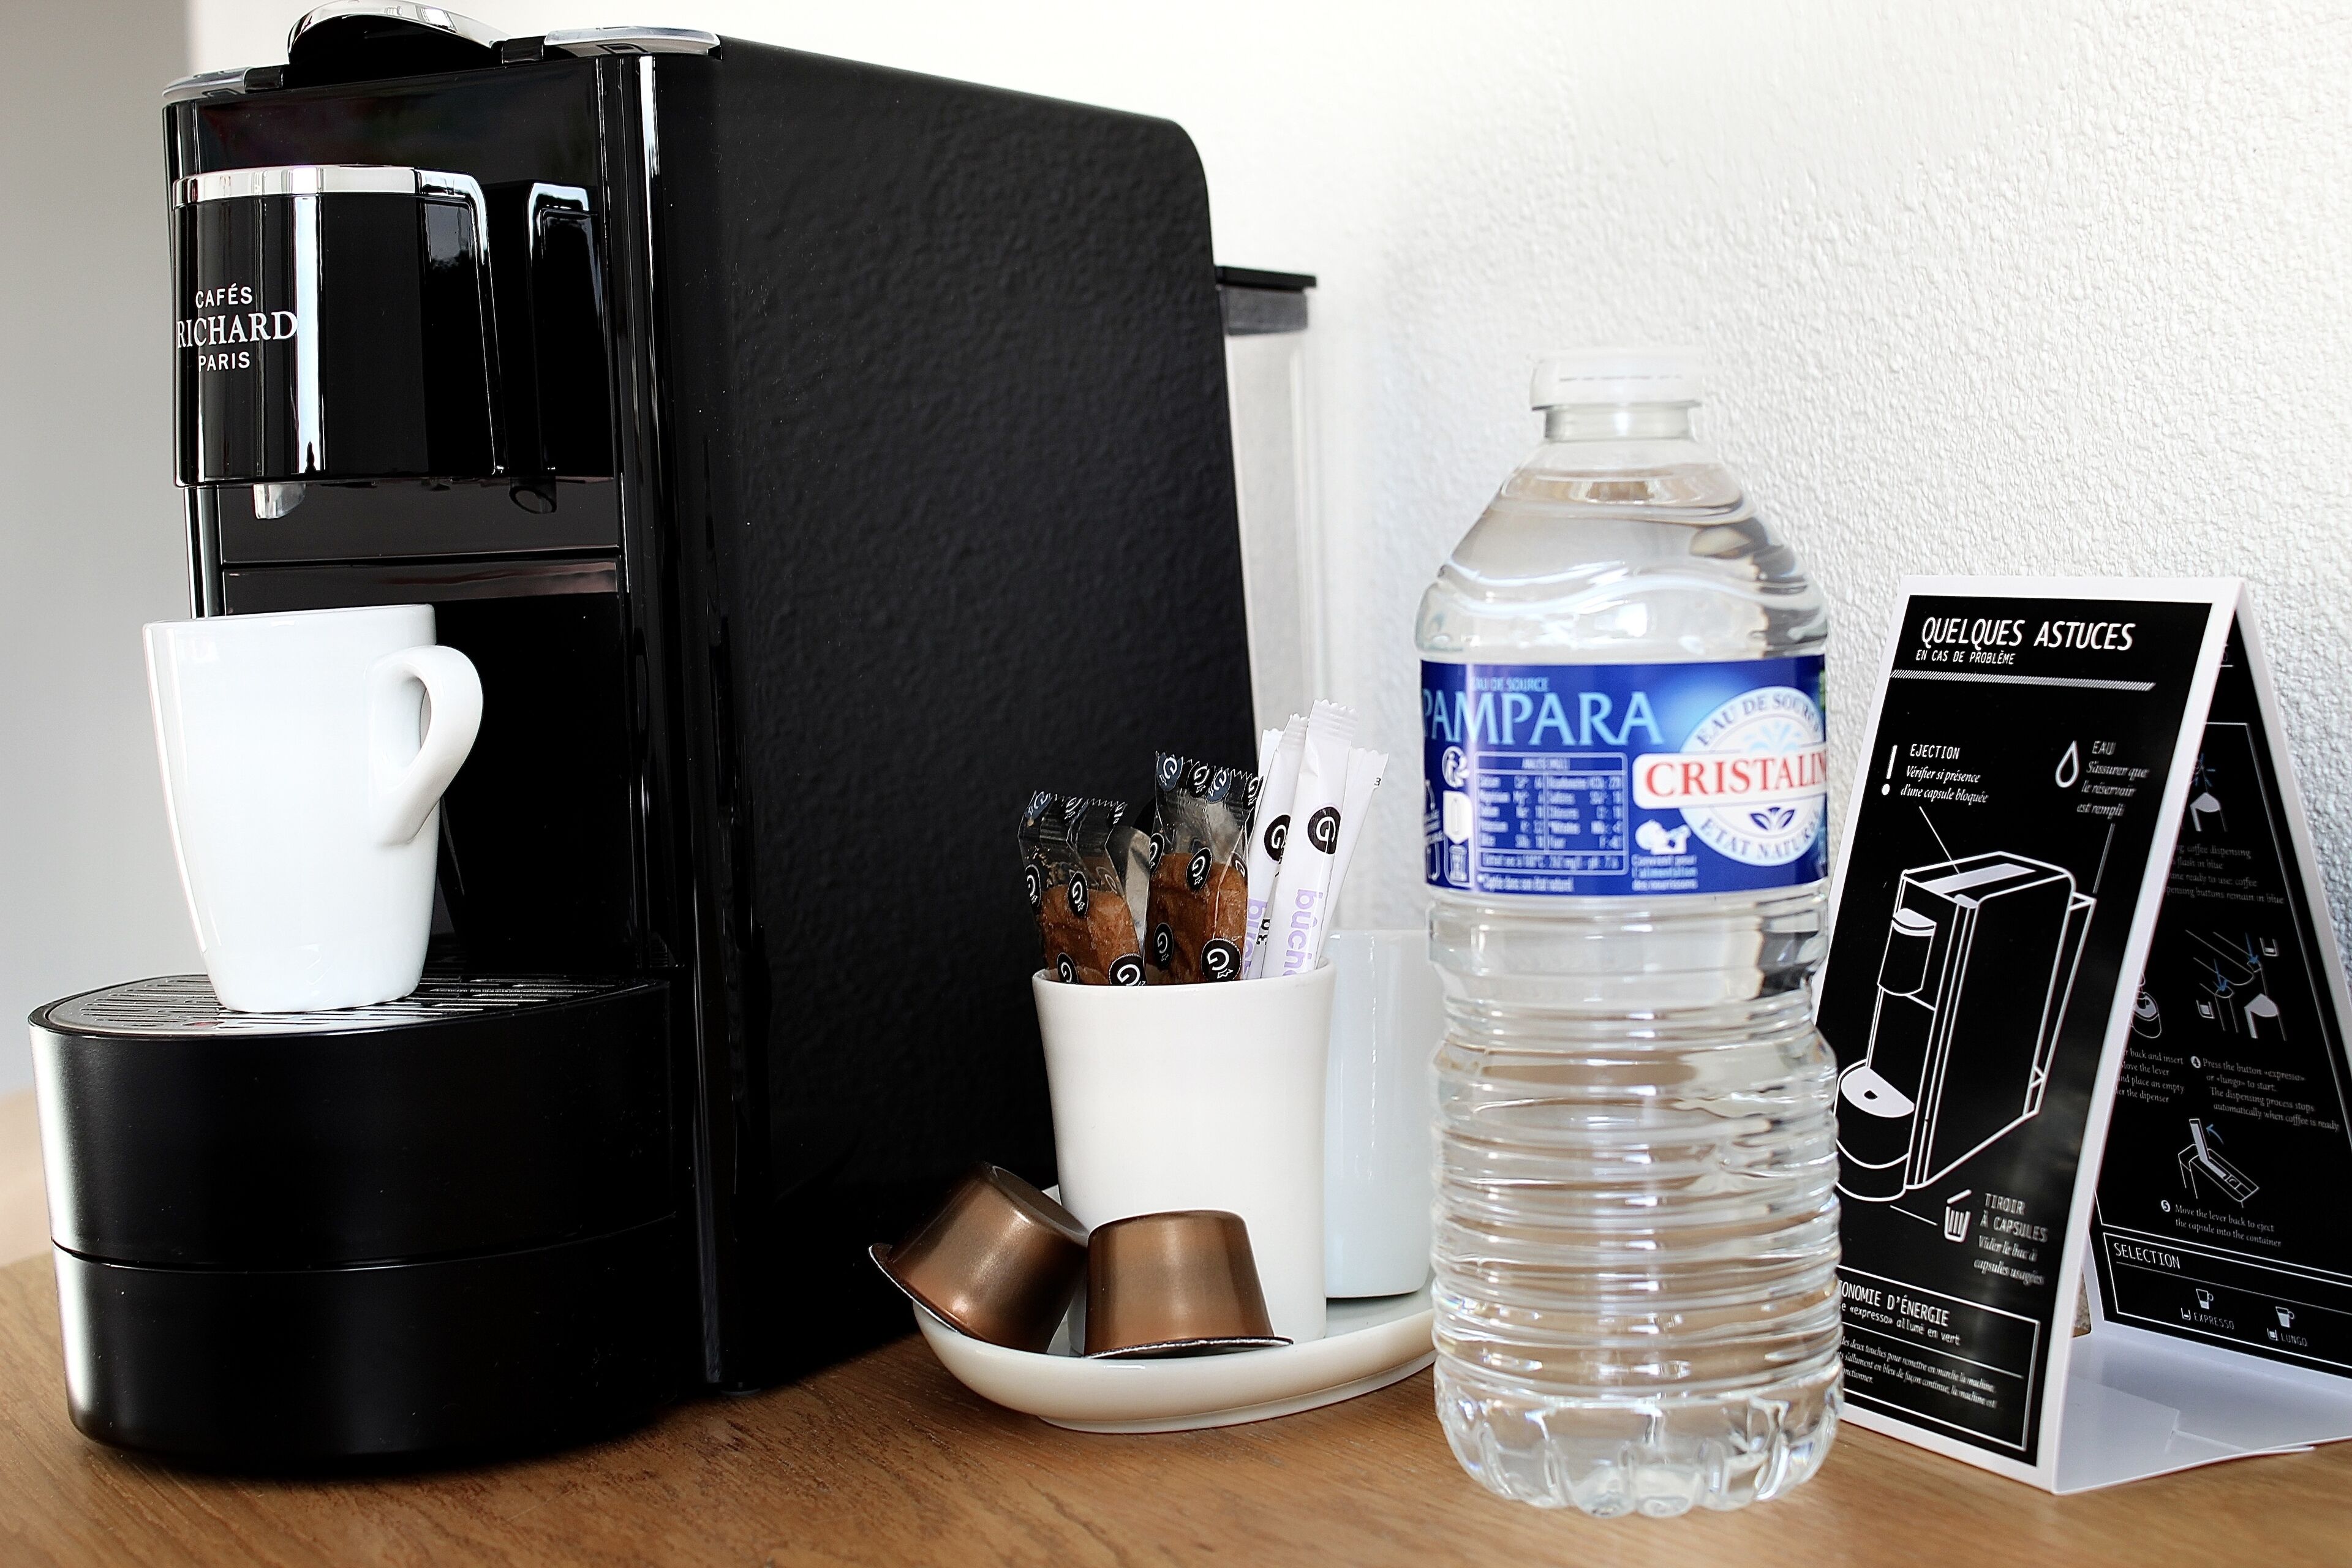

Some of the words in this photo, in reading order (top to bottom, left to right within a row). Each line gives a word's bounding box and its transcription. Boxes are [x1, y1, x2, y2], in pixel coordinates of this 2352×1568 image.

[195, 283, 252, 308] CAFÉS
[177, 311, 298, 349] RICHARD
[198, 352, 251, 371] PARIS
[1922, 617, 2026, 650] QUELQUES
[2034, 621, 2136, 650] ASTUCES
[1915, 650, 1929, 661] EN
[1931, 650, 1948, 662] CAS
[1953, 651, 1965, 663] DE
[1969, 650, 2016, 665] PROBLÈME
[1742, 695, 1767, 715] DE
[1910, 744, 1961, 760] EJECTION
[2092, 741, 2116, 755] EAU
[1906, 766, 1936, 782] Vérifier
[1936, 769, 1945, 780] si
[1943, 769, 1981, 784] présence
[2128, 768, 2150, 781] que
[1901, 784, 1923, 797] d'une
[1924, 788, 1955, 802] capsule
[1955, 788, 1989, 805] bloquée
[2081, 780, 2092, 793] le
[2092, 782, 2136, 796] réservoir
[2076, 802, 2092, 813] est
[2092, 802, 2125, 820] rempli
[2187, 843, 2208, 856] coffee
[2209, 845, 2252, 859] dispensing
[2206, 859, 2223, 870] blue
[2186, 872, 2206, 885] ready
[2234, 877, 2258, 889] coffee
[2196, 887, 2225, 899] buttons
[2226, 892, 2254, 902] remain
[2266, 893, 2285, 904] blue
[2130, 1047, 2147, 1059] back
[2148, 1052, 2162, 1061] and
[2163, 1054, 2184, 1065] insert
[2140, 1063, 2151, 1073] the
[2152, 1065, 2169, 1076] lever
[2203, 1058, 2222, 1069] Press
[2223, 1061, 2234, 1071] the
[2236, 1063, 2262, 1075] button
[2127, 1088, 2138, 1098] the
[2139, 1090, 2169, 1102] dipenser
[2132, 1076, 2149, 1087] place
[2162, 1082, 2184, 1095] empty
[2209, 1087, 2223, 1096] The
[2225, 1090, 2265, 1106] dispensing
[2266, 1098, 2293, 1108] process
[2295, 1103, 2315, 1114] stops
[2214, 1103, 2263, 1120] automatically
[2264, 1110, 2284, 1121] when
[2318, 1121, 2340, 1132] ready
[1985, 1193, 2026, 1216] TIROIR
[1980, 1210, 1989, 1227] À
[1993, 1215, 2048, 1243] CAPSULES
[2176, 1204, 2195, 1216] Move
[2196, 1208, 2207, 1218] the
[2209, 1210, 2226, 1223] lever
[2228, 1214, 2246, 1226] back
[2247, 1219, 2255, 1228] to
[2256, 1223, 2274, 1232] eject
[2176, 1218, 2187, 1227] the
[2188, 1223, 2215, 1233] capsule
[2217, 1227, 2231, 1237] into
[2233, 1230, 2244, 1240] the
[2246, 1234, 2282, 1247] container
[1978, 1235, 2002, 1253] Vider
[2002, 1240, 2011, 1256] le
[2114, 1242, 2181, 1270] SELECTION
[1973, 1259, 2010, 1276] capsules
[2010, 1268, 2045, 1286] usagées
[1839, 1280, 1882, 1307] ONOMIE
[1887, 1294, 1951, 1327] D'ÉNERGIE
[1850, 1305, 1894, 1325] «expresso»
[1896, 1319, 1924, 1335] allumé
[1927, 1328, 1939, 1338] en
[1940, 1332, 1961, 1346] vert
[2193, 1312, 2235, 1330] EXPRESSO
[2281, 1332, 2309, 1348] LUNGO
[1850, 1339, 1865, 1351] deux
[1866, 1345, 1887, 1359] touches
[1887, 1352, 1901, 1363] pour
[1902, 1357, 1928, 1371] remettre
[1928, 1364, 1937, 1373] en
[1936, 1366, 1959, 1382] marche
[1959, 1372, 1967, 1383] la
[1845, 1352, 1874, 1370] s'allument
[1874, 1363, 1882, 1371] en
[1882, 1363, 1896, 1376] bleu
[1896, 1368, 1904, 1378] de
[1903, 1371, 1921, 1384] façon
[1951, 1385, 1959, 1395] la
[1958, 1388, 1986, 1403] machine
[1985, 1398, 1997, 1409] est
